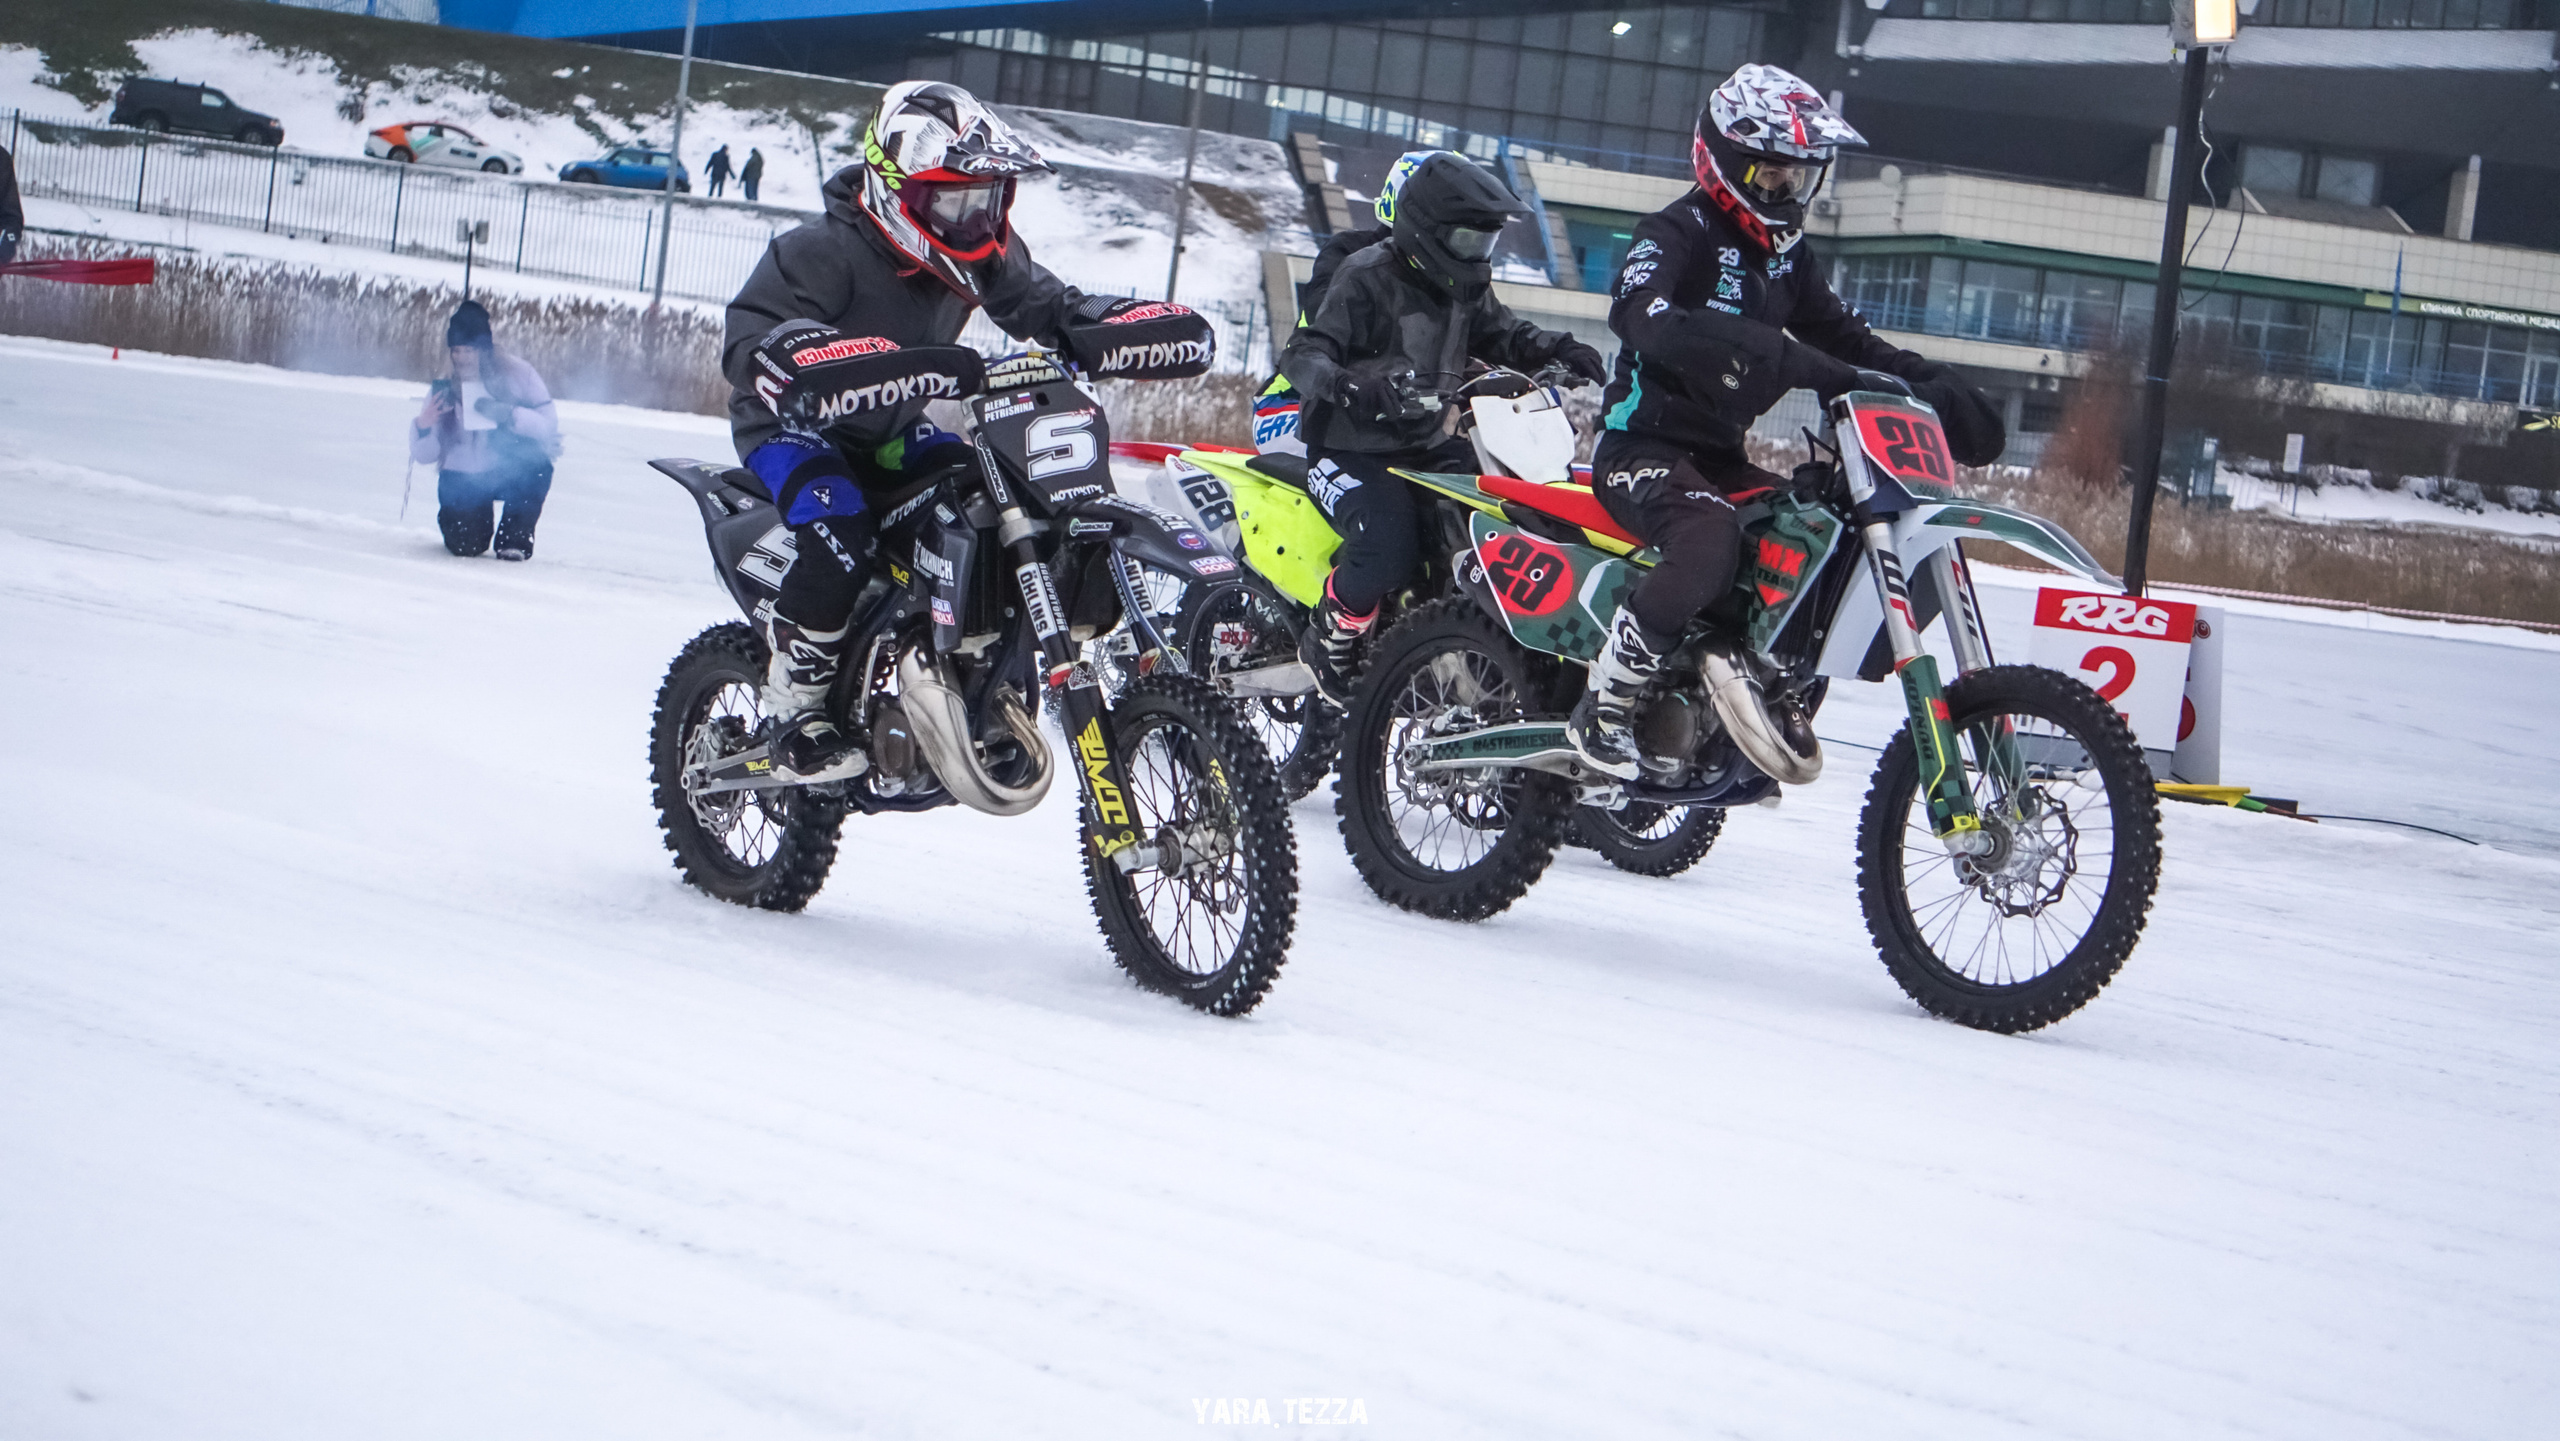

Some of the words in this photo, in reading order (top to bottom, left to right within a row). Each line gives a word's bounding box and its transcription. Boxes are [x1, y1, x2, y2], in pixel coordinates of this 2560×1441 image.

[1718, 247, 1740, 266] 29
[2420, 302, 2462, 317] КЛИНИКА
[2465, 307, 2526, 324] СПОРТИВНОЙ
[795, 343, 877, 365] YAKHNICH
[818, 372, 961, 420] MOTOKIDZ
[984, 396, 1011, 412] ALENA
[985, 401, 1035, 423] PETRISHINA
[1875, 415, 1950, 482] 29
[1179, 474, 1237, 532] 128
[1193, 556, 1229, 567] LIQUI
[1199, 563, 1235, 575] MOLY
[1487, 535, 1566, 612] 29
[1758, 538, 1806, 577] MX
[1019, 568, 1049, 634] ÖHLINS
[2058, 596, 2170, 636] RRG
[2079, 645, 2136, 730] 2
[1903, 669, 1936, 761] DUNLOP
